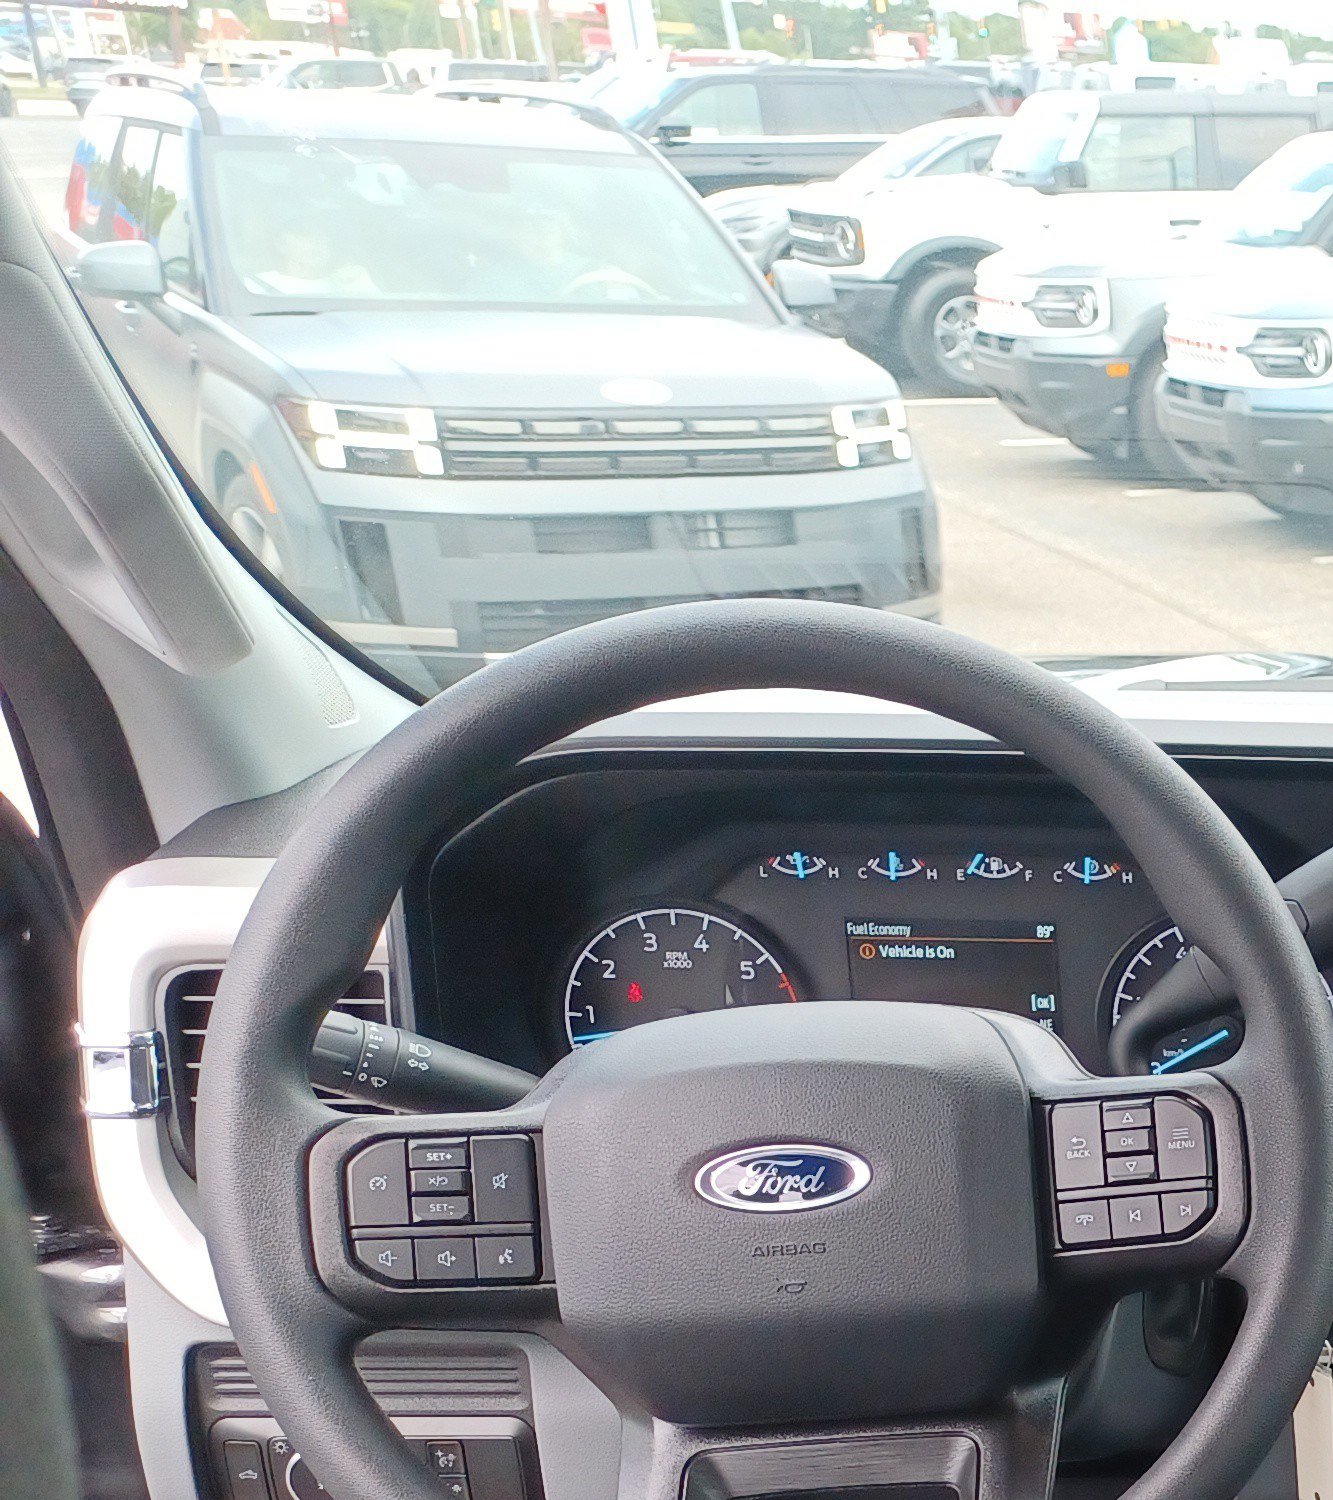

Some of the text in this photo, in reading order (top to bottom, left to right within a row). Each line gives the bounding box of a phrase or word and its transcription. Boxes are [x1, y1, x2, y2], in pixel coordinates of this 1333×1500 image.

[759, 866, 768, 878] L
[828, 867, 840, 878] H
[858, 867, 868, 880] C
[926, 868, 938, 880] H
[956, 869, 966, 881] E
[1025, 870, 1033, 882] F
[1053, 870, 1063, 883] C
[1122, 872, 1133, 884] H
[846, 922, 912, 938] Fuel Economy
[643, 932, 658, 952] 3
[693, 934, 710, 952] 4
[665, 951, 688, 960] RPM
[878, 944, 924, 958] Vehicle
[936, 946, 955, 959] On
[602, 960, 617, 979] 2
[663, 960, 693, 969] x1000
[740, 960, 756, 980] 5
[585, 1004, 595, 1024] 1
[1120, 1138, 1134, 1146] OK
[1168, 1140, 1196, 1150] MENU
[1066, 1150, 1091, 1160] BACK
[738, 1158, 826, 1197] Ford
[752, 1242, 827, 1258] AIRBAG
